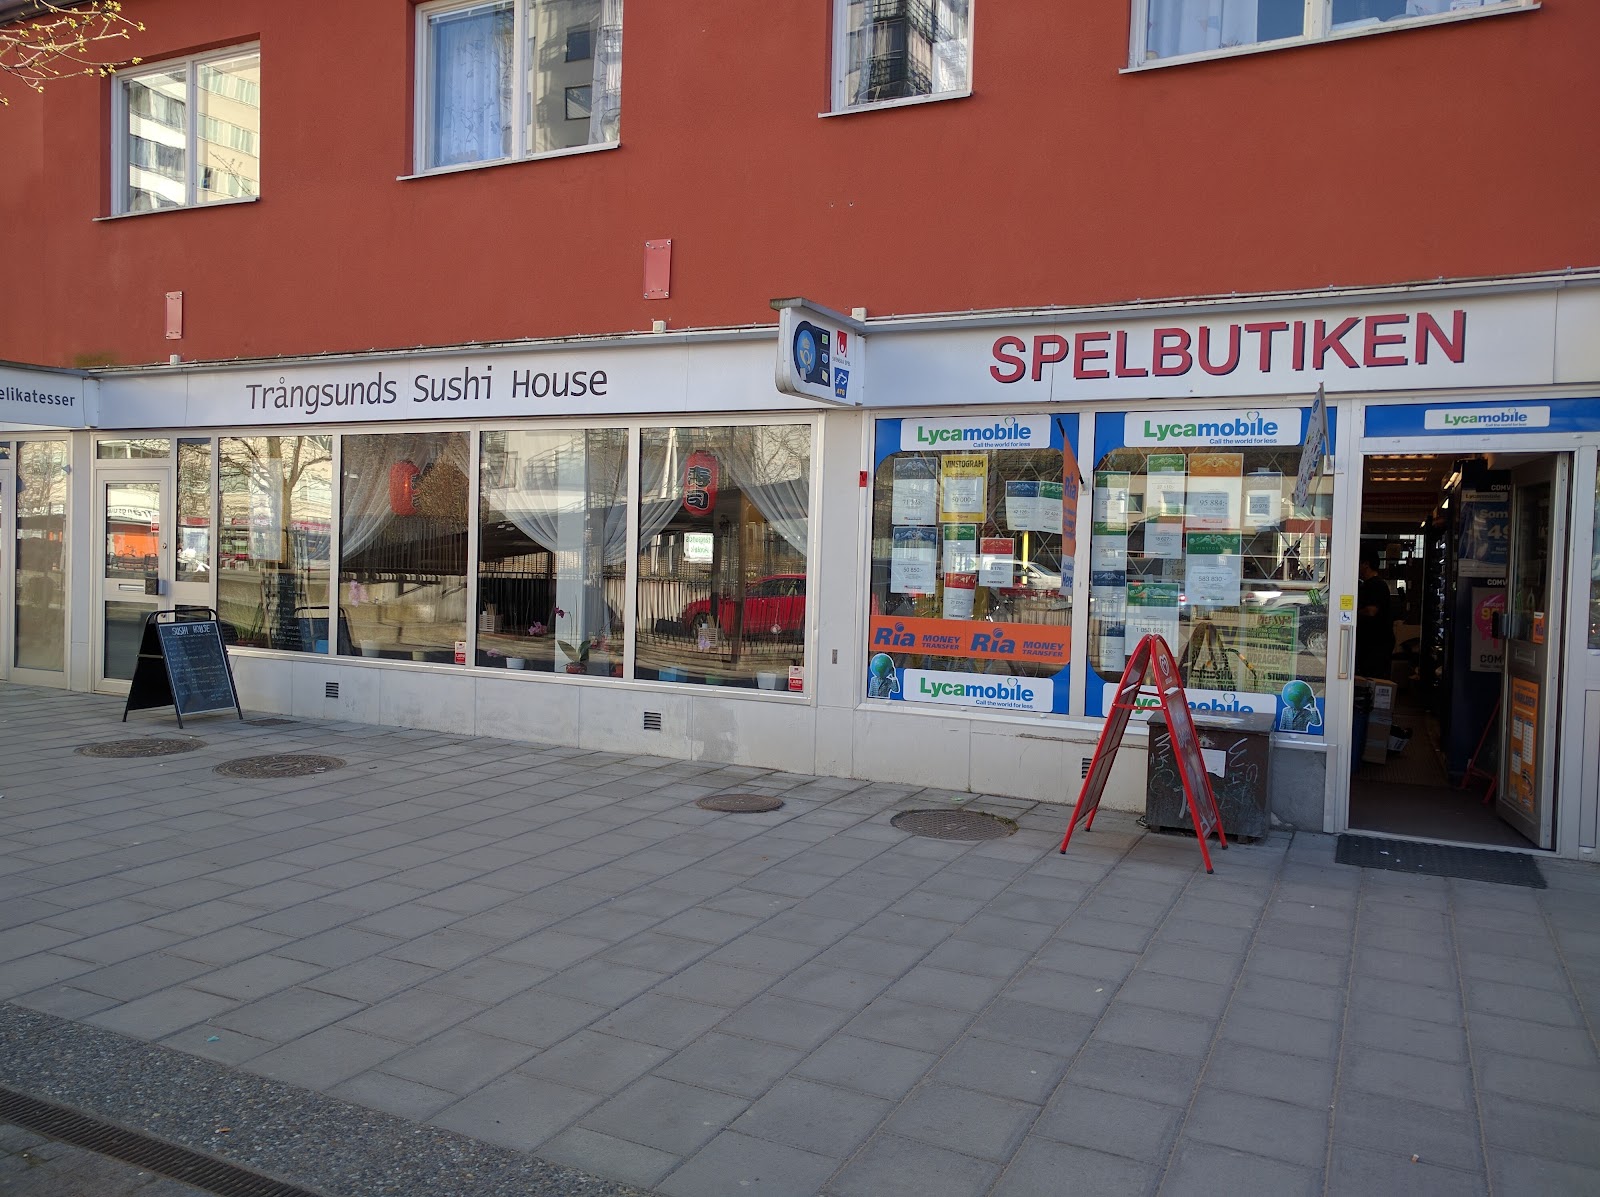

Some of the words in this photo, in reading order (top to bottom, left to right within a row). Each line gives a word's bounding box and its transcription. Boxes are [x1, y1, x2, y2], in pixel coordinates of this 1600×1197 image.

[990, 309, 1467, 384] SPELBUTIKEN
[245, 371, 397, 415] Trångsunds
[413, 365, 492, 403] Sushi
[512, 369, 608, 399] House
[1143, 413, 1279, 441] Lycamobile
[1444, 409, 1528, 425] Lycamobile
[917, 418, 1032, 445] Lycamobile
[945, 460, 984, 468] VINSTOGRAM
[1064, 472, 1077, 501] Ria
[1062, 572, 1073, 588] Here
[192, 624, 211, 634] HOUSE
[873, 622, 916, 647] Ria
[922, 634, 961, 644] MONEY
[970, 628, 1016, 654] Ria
[1023, 641, 1065, 650] MONEY
[920, 678, 1034, 702] Lycamobile
